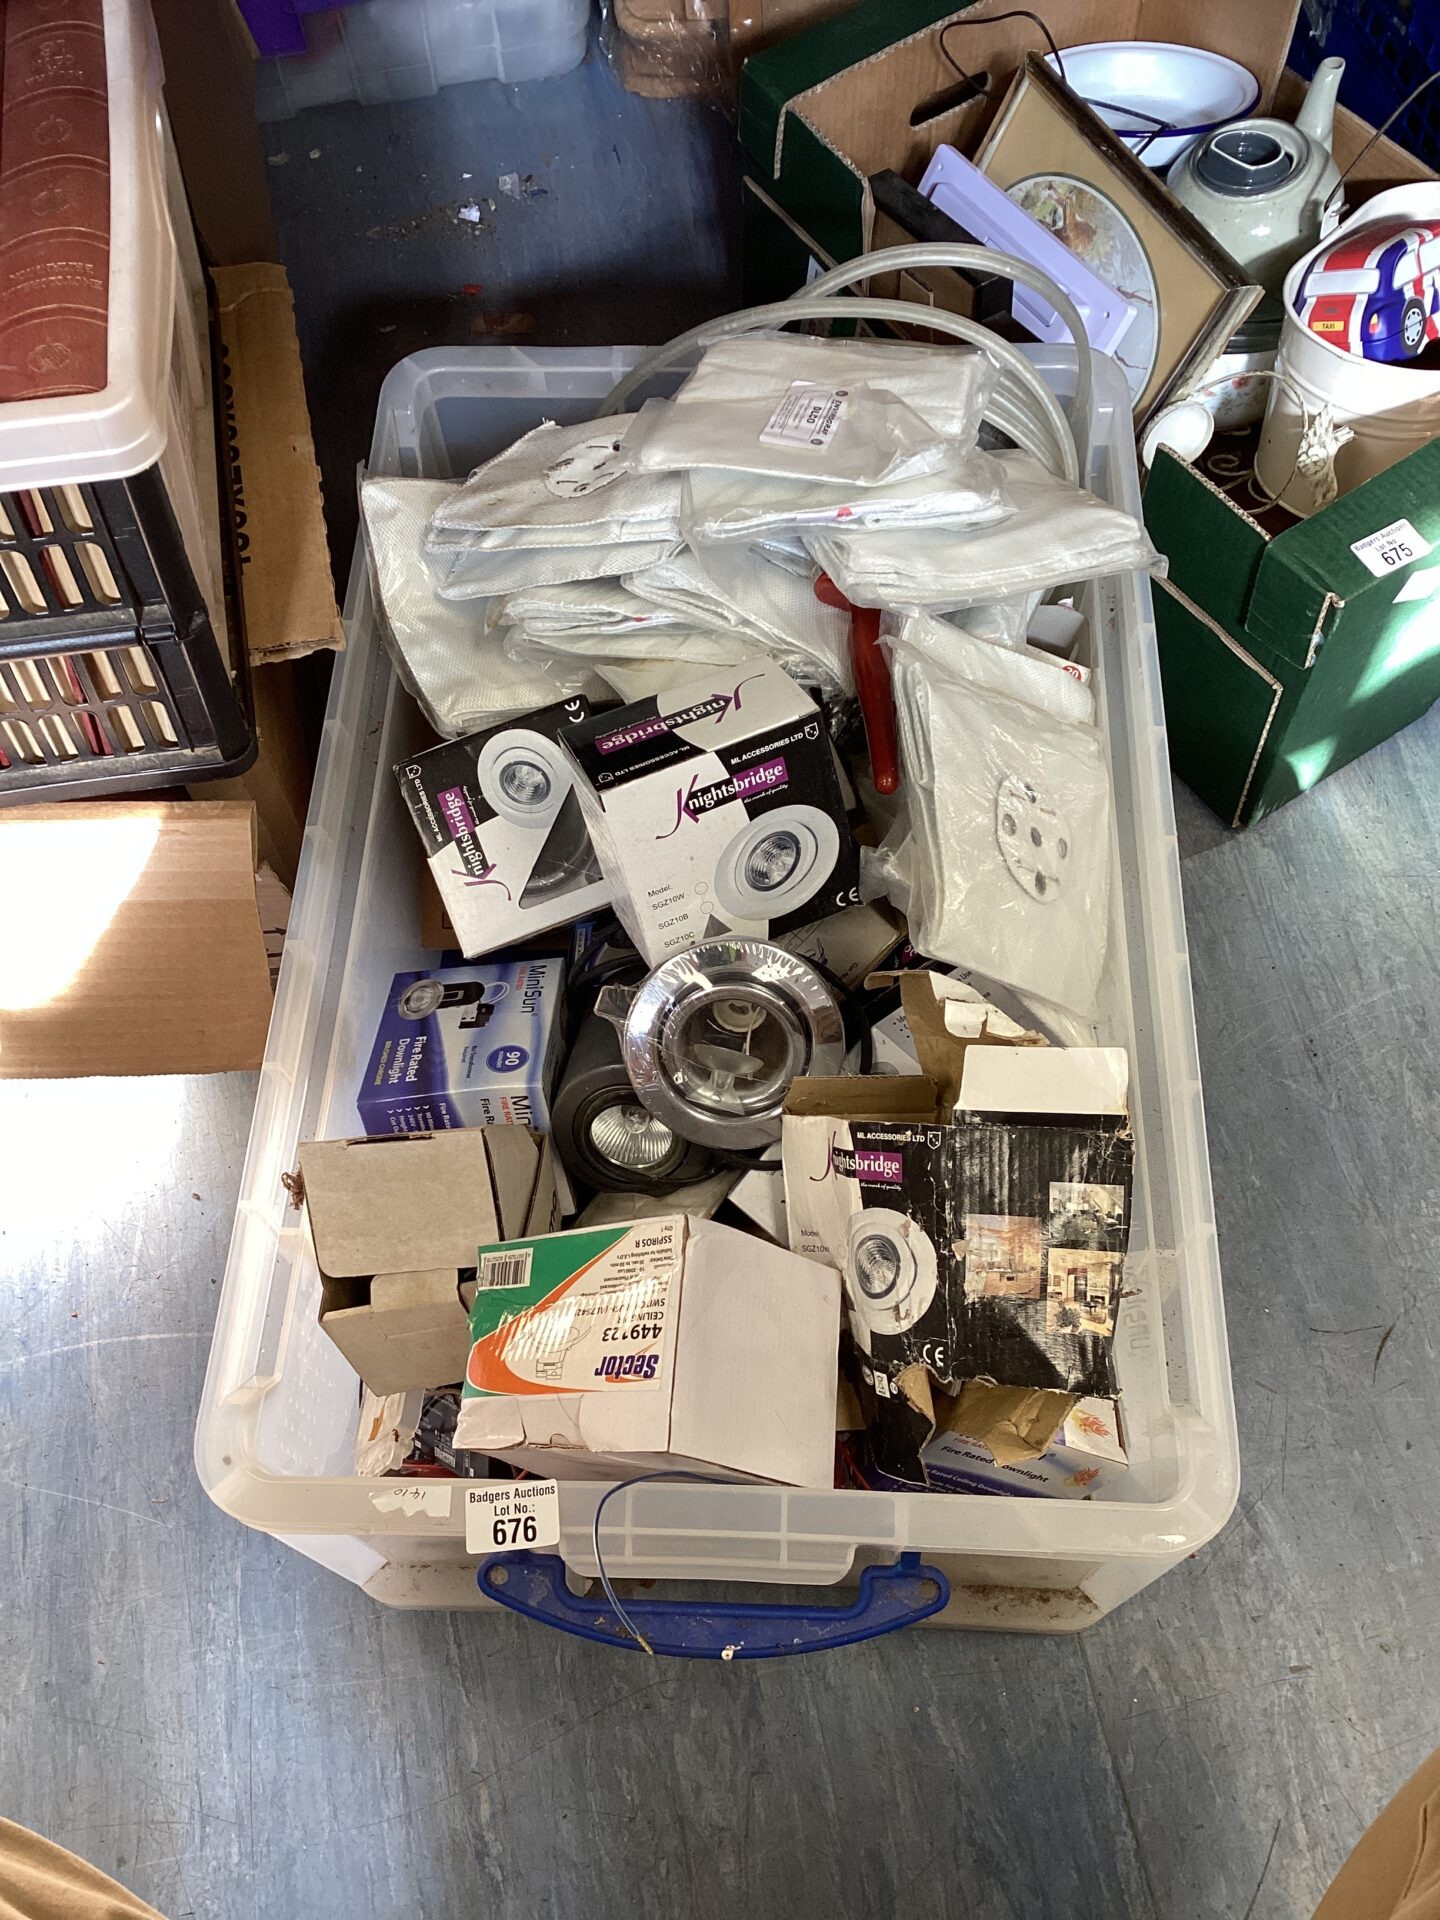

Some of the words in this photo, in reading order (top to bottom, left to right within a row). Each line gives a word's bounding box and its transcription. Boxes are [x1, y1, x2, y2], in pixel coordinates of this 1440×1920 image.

[1353, 535, 1381, 552] Badgers
[1380, 522, 1408, 539] Auctions
[1381, 542, 1413, 566] 675
[731, 756, 742, 765] ML
[742, 737, 790, 762] ACCESSORIES
[790, 731, 804, 743] LTD
[655, 763, 784, 840] Knightsbridge
[445, 791, 511, 901] Knightsbridge
[651, 892, 686, 911] SGZ10W
[658, 913, 689, 930] SGZ10B
[663, 931, 695, 948] SGZ10C
[520, 964, 548, 1014] MiniSun
[412, 1035, 428, 1054] Fire
[388, 1038, 410, 1085] Downlight
[404, 1054, 422, 1082] Rated
[504, 1051, 521, 1066] 90
[438, 1102, 448, 1114] Fire
[480, 1098, 492, 1114] Fire
[499, 1096, 508, 1111] FIRE
[856, 1131, 866, 1139] ML
[866, 1131, 911, 1142] ACCESSORIES
[912, 1134, 925, 1143] LTD
[635, 1239, 641, 1248] R
[641, 1234, 673, 1247] SSPIROS
[594, 1354, 660, 1380] Sector
[940, 1445, 962, 1456] Fire
[961, 1451, 995, 1464] Rated
[1001, 1464, 1050, 1482] ownlight
[469, 1490, 511, 1504] Badgers
[513, 1485, 556, 1499] Auctions
[493, 1505, 511, 1517] Lot
[513, 1503, 536, 1514] No.:
[492, 1515, 537, 1546] 676
